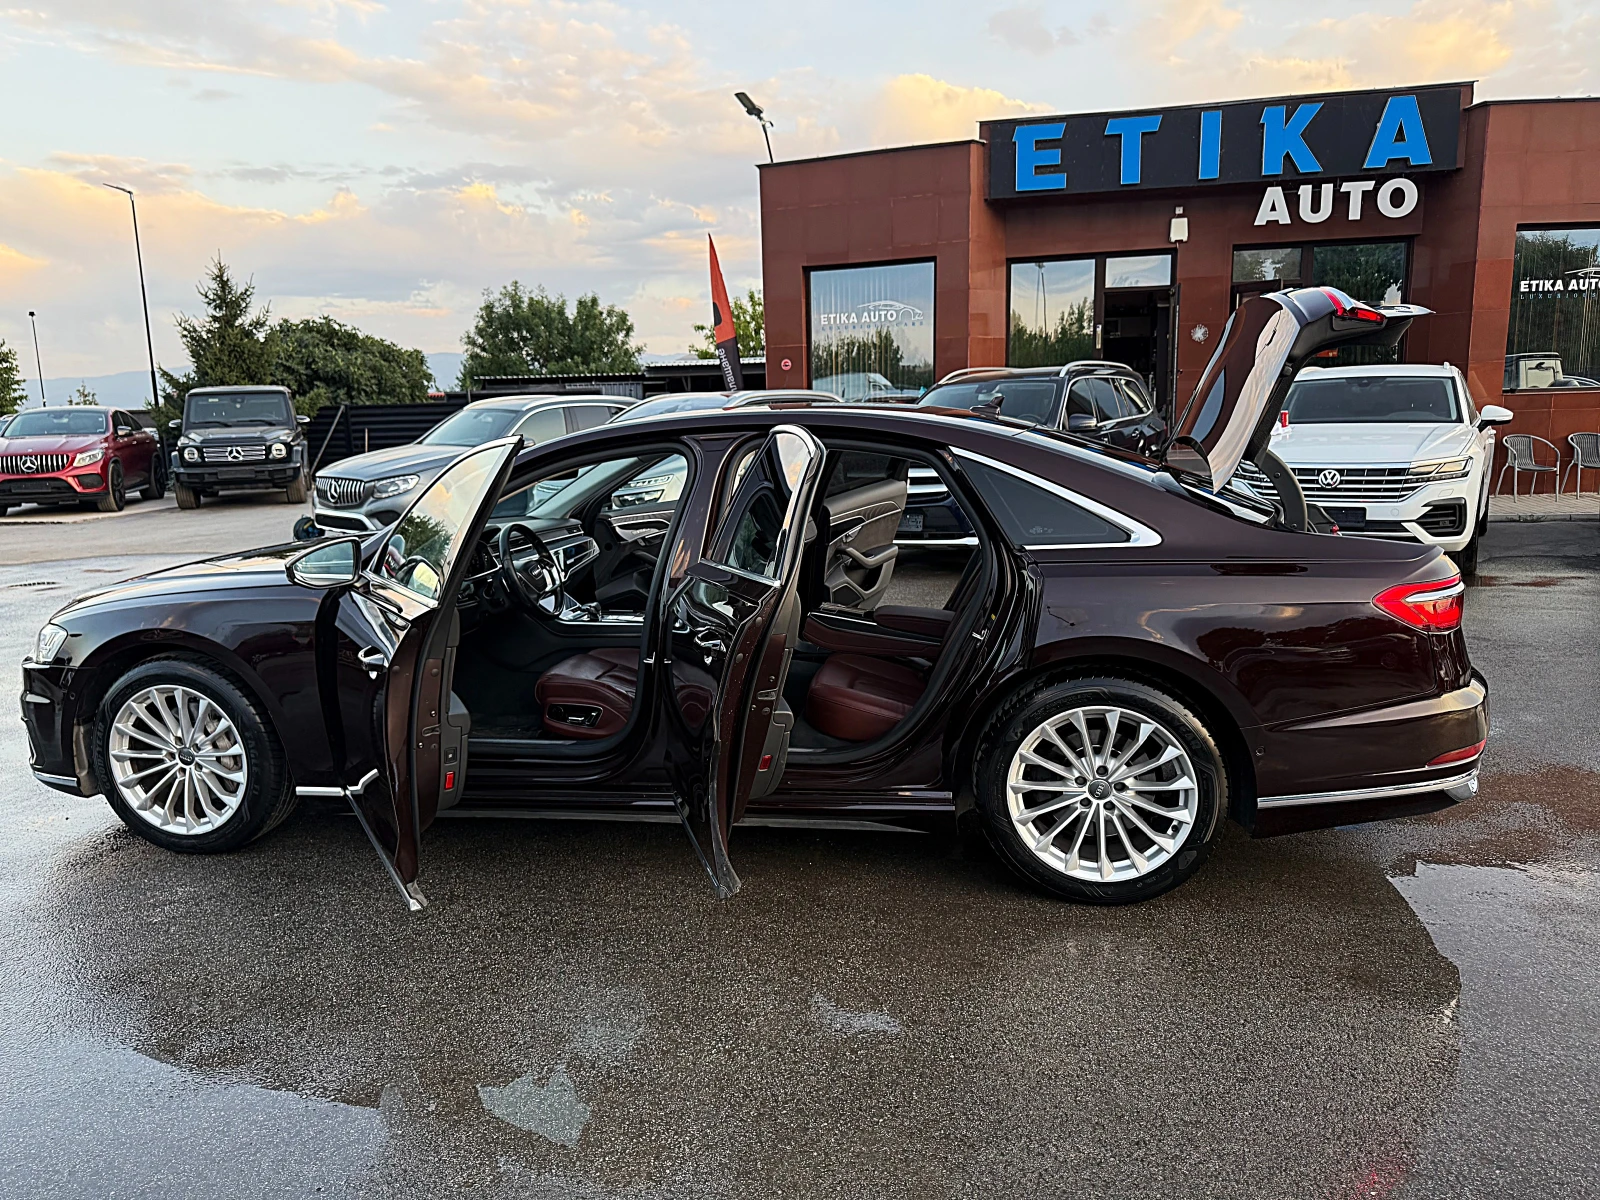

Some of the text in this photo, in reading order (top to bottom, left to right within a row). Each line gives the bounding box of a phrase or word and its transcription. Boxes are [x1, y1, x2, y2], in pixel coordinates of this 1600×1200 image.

[1012, 95, 1432, 191] ETIKA
[1254, 178, 1418, 226] AUTO
[1520, 279, 1600, 291] ETIKA AUT
[820, 310, 897, 325] ETIKA AUTO
